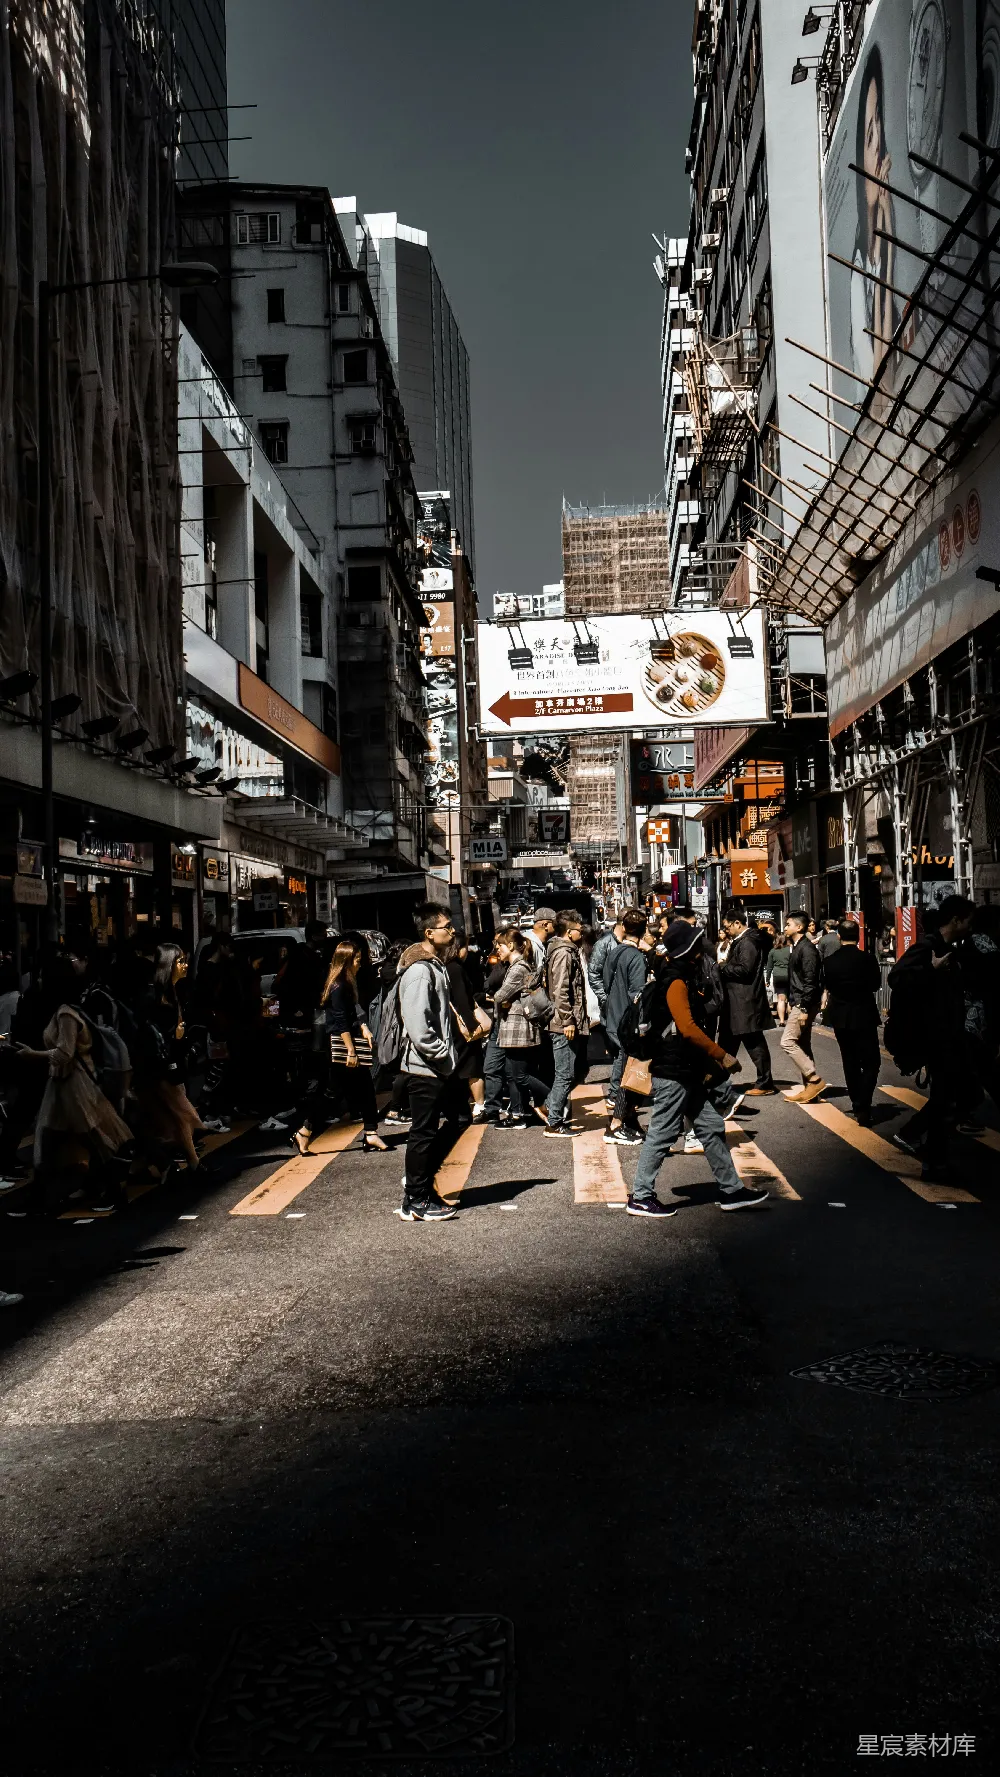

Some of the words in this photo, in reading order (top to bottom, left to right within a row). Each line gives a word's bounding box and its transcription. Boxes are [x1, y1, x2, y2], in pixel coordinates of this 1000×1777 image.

[531, 652, 565, 660] ARADISE
[586, 702, 604, 712] Plaza
[473, 841, 503, 854] MIA
[487, 851, 503, 859] hair
